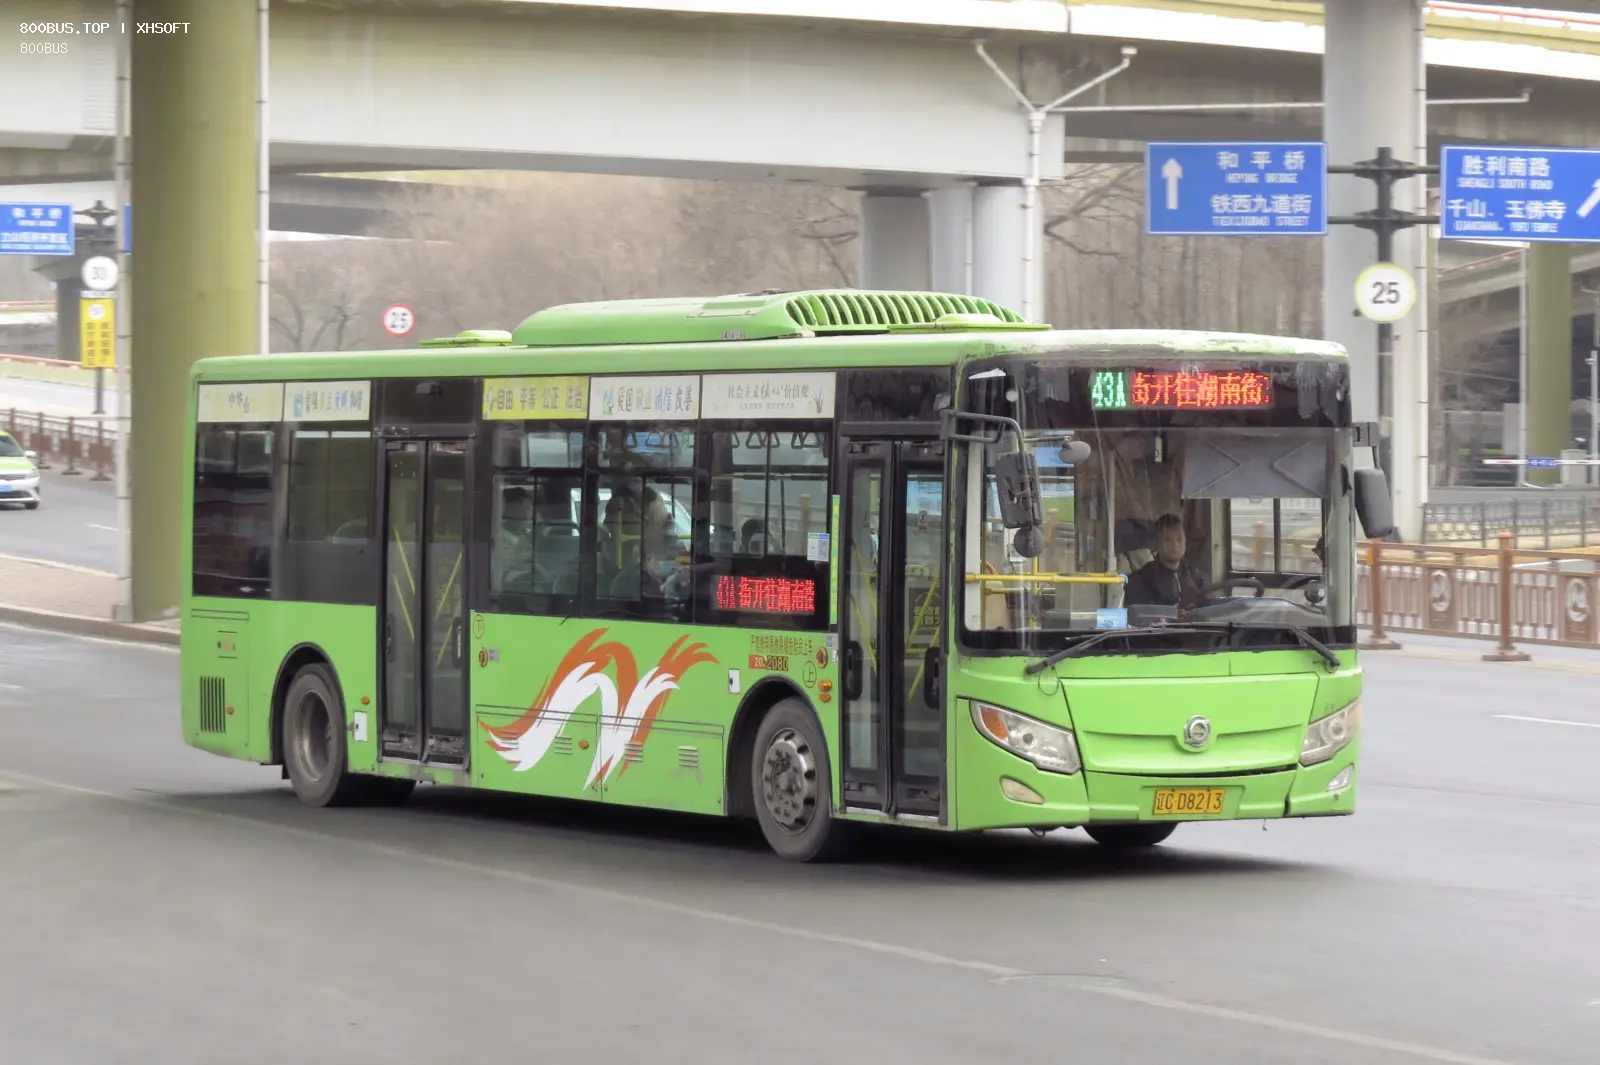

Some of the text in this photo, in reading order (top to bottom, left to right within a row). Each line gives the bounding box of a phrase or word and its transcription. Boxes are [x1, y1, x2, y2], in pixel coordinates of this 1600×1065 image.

[1461, 155, 1550, 177] 胜利南路
[1210, 194, 1312, 213] 铁西九道街
[1372, 281, 1400, 304] 25
[390, 311, 408, 329] 25
